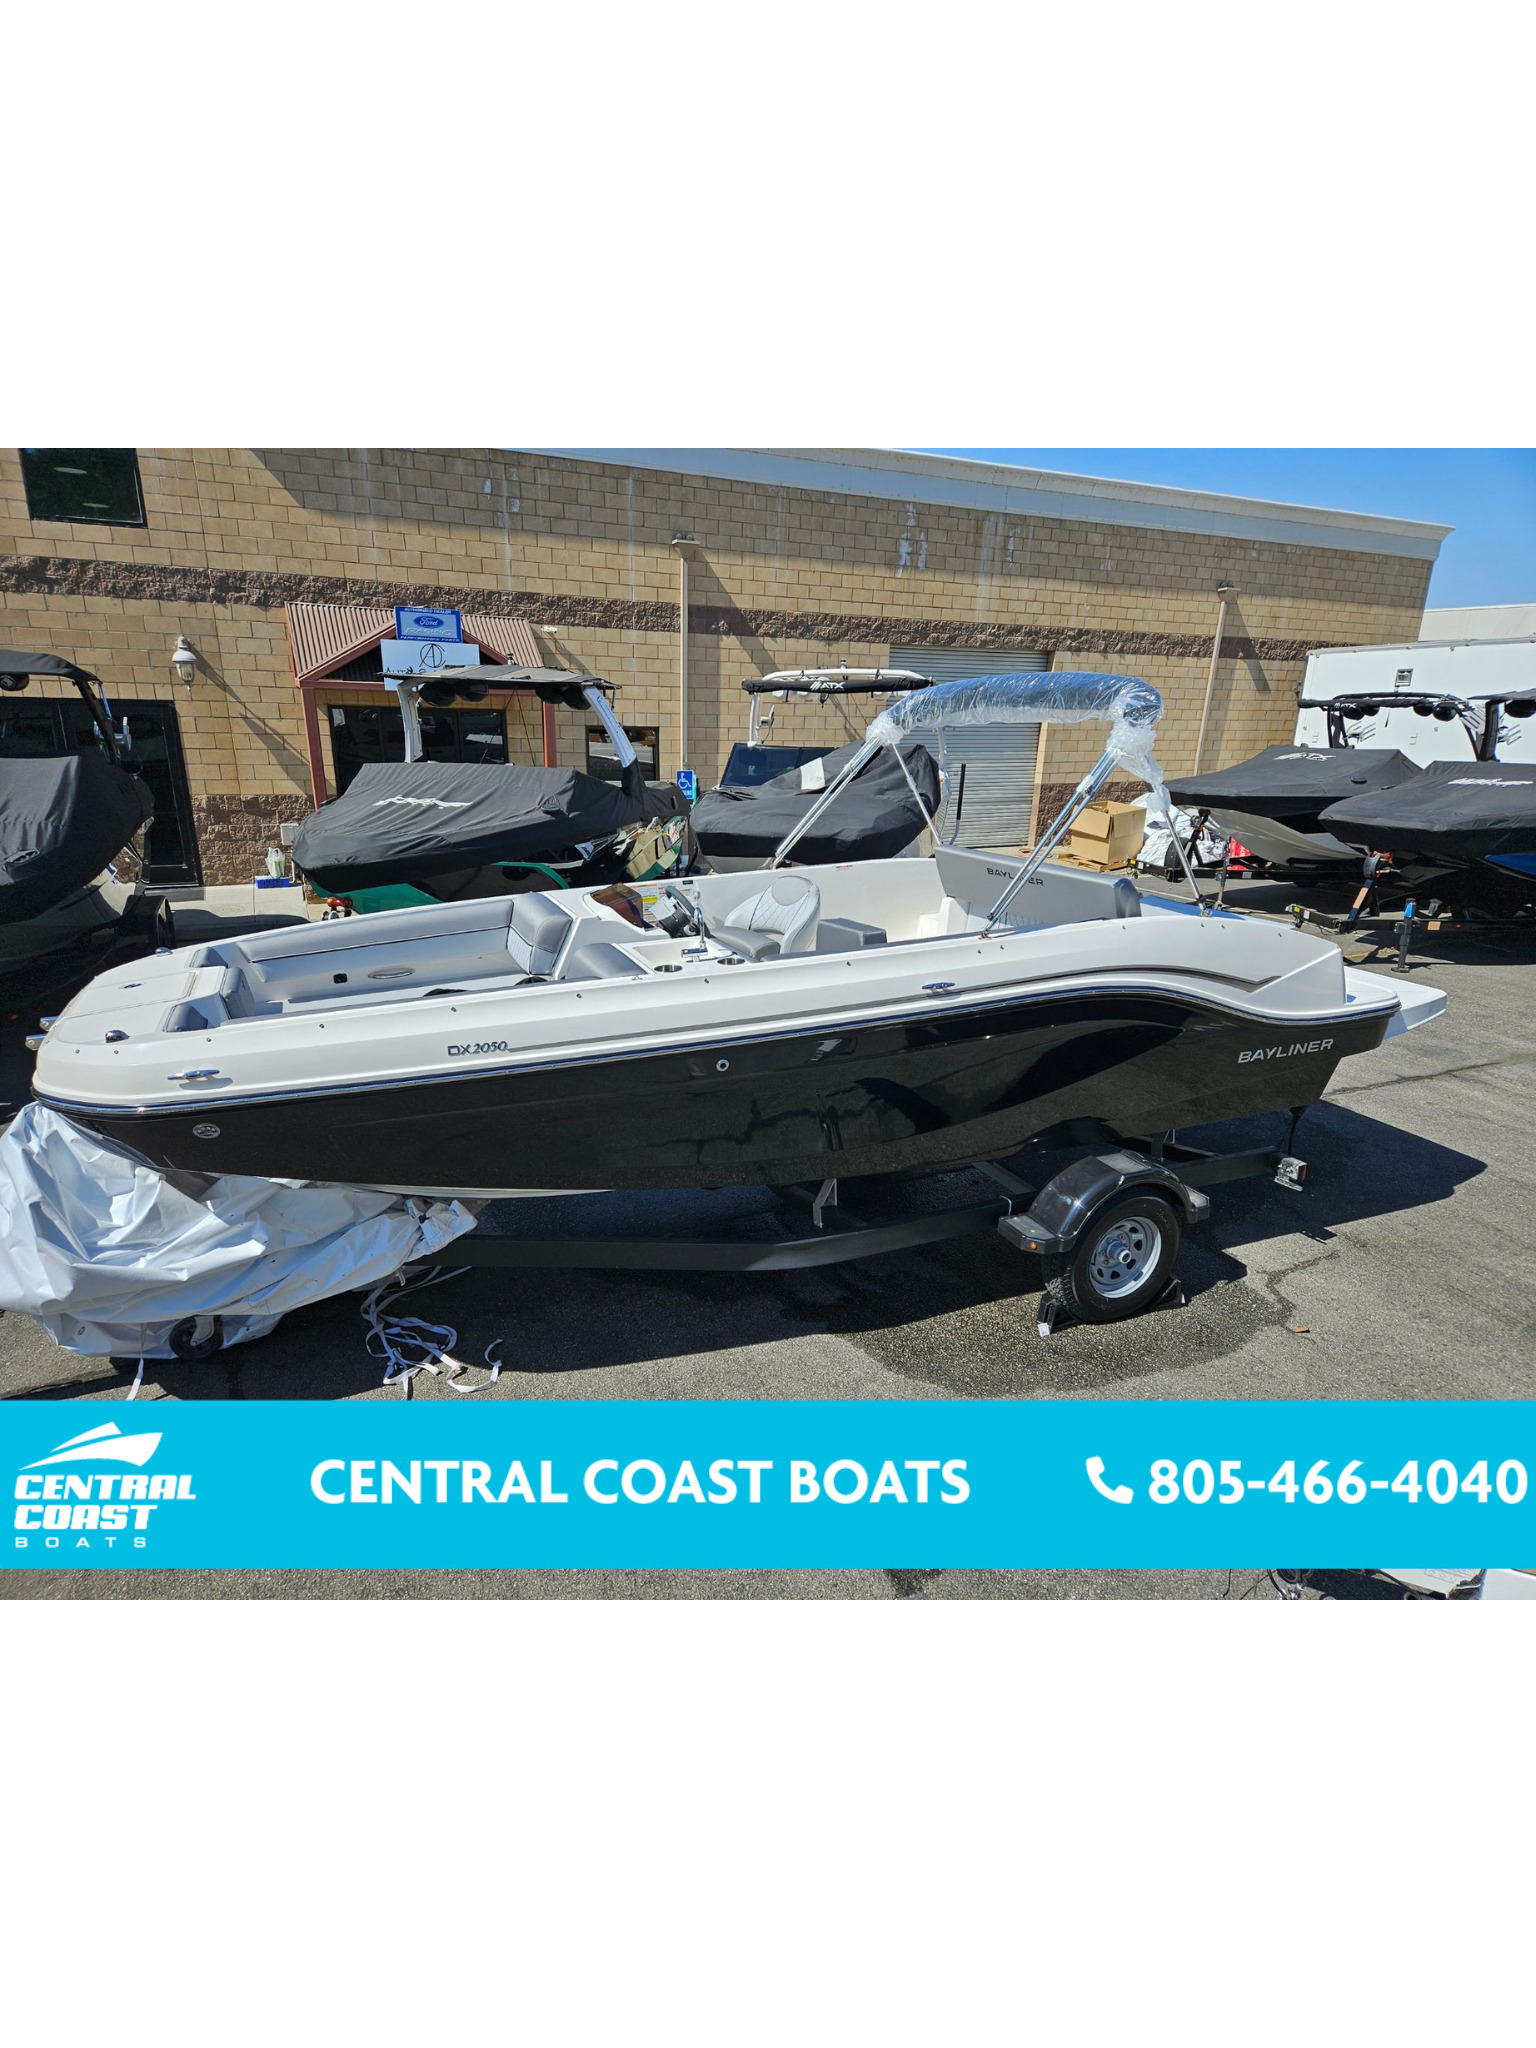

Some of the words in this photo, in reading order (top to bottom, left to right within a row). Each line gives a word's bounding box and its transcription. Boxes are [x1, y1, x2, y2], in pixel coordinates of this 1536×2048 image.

[419, 616, 438, 626] Ford
[819, 681, 846, 689] ATX
[986, 867, 1044, 886] BAYLER
[1237, 1038, 1334, 1064] BAYLINER
